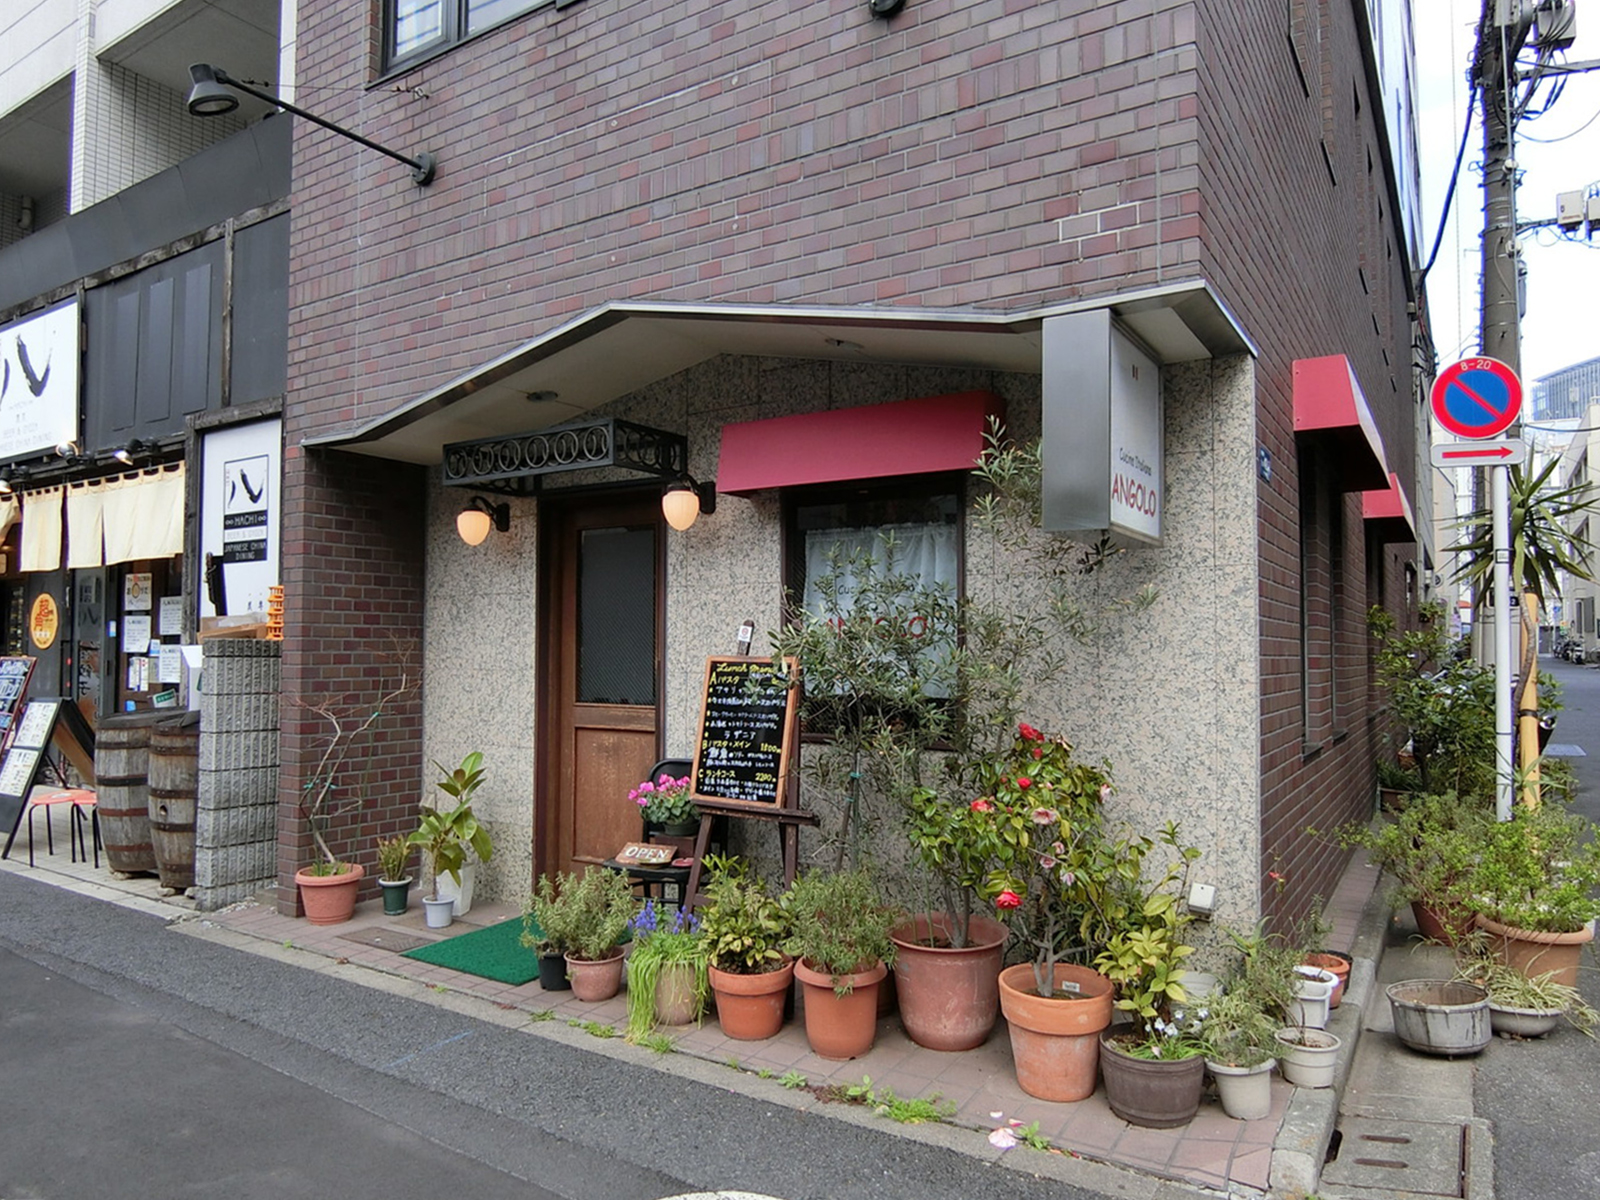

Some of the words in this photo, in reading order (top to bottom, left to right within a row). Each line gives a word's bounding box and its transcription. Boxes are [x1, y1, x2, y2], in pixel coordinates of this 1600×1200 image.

[1460, 359, 1492, 371] 8-20
[1111, 473, 1157, 518] ANGOLO
[234, 514, 258, 527] HACHI
[224, 542, 249, 553] JAPANESE
[235, 551, 256, 561] DINING
[716, 662, 748, 673] Lunch
[709, 671, 717, 685] A
[698, 768, 704, 778] C
[624, 846, 670, 859] OPEN
